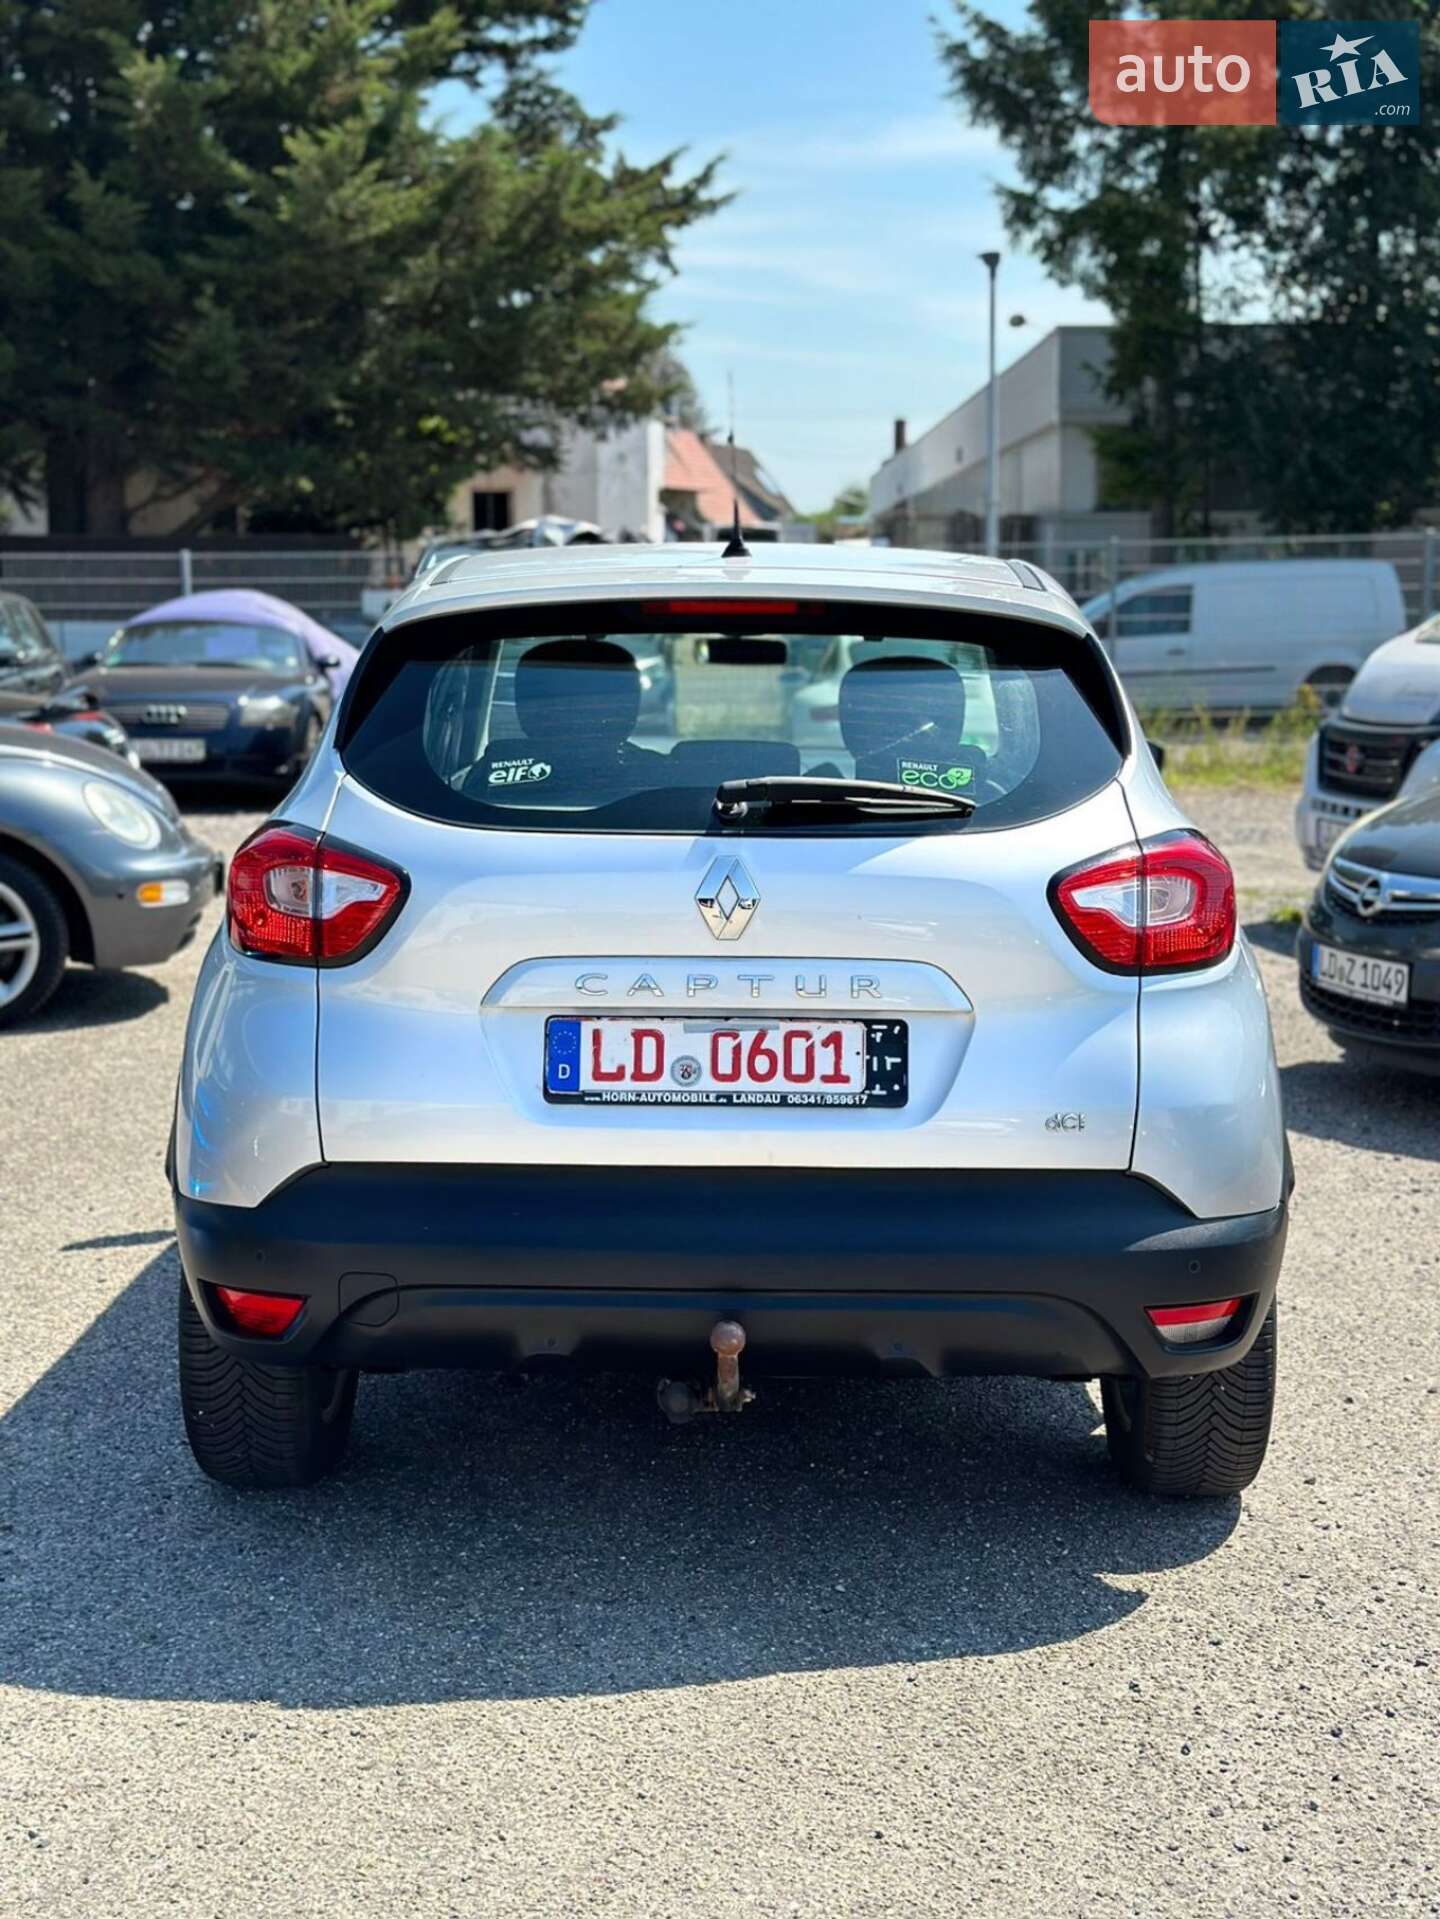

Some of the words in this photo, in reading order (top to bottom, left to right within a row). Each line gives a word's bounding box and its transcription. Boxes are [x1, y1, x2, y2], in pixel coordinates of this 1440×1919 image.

[491, 758, 535, 769] RENAULT
[901, 761, 938, 771] RENAULT
[574, 972, 881, 998] CAPTUR
[591, 1028, 665, 1082] LD
[711, 1028, 851, 1083] 0601
[558, 1063, 571, 1079] D
[733, 1093, 780, 1104] LANDAU
